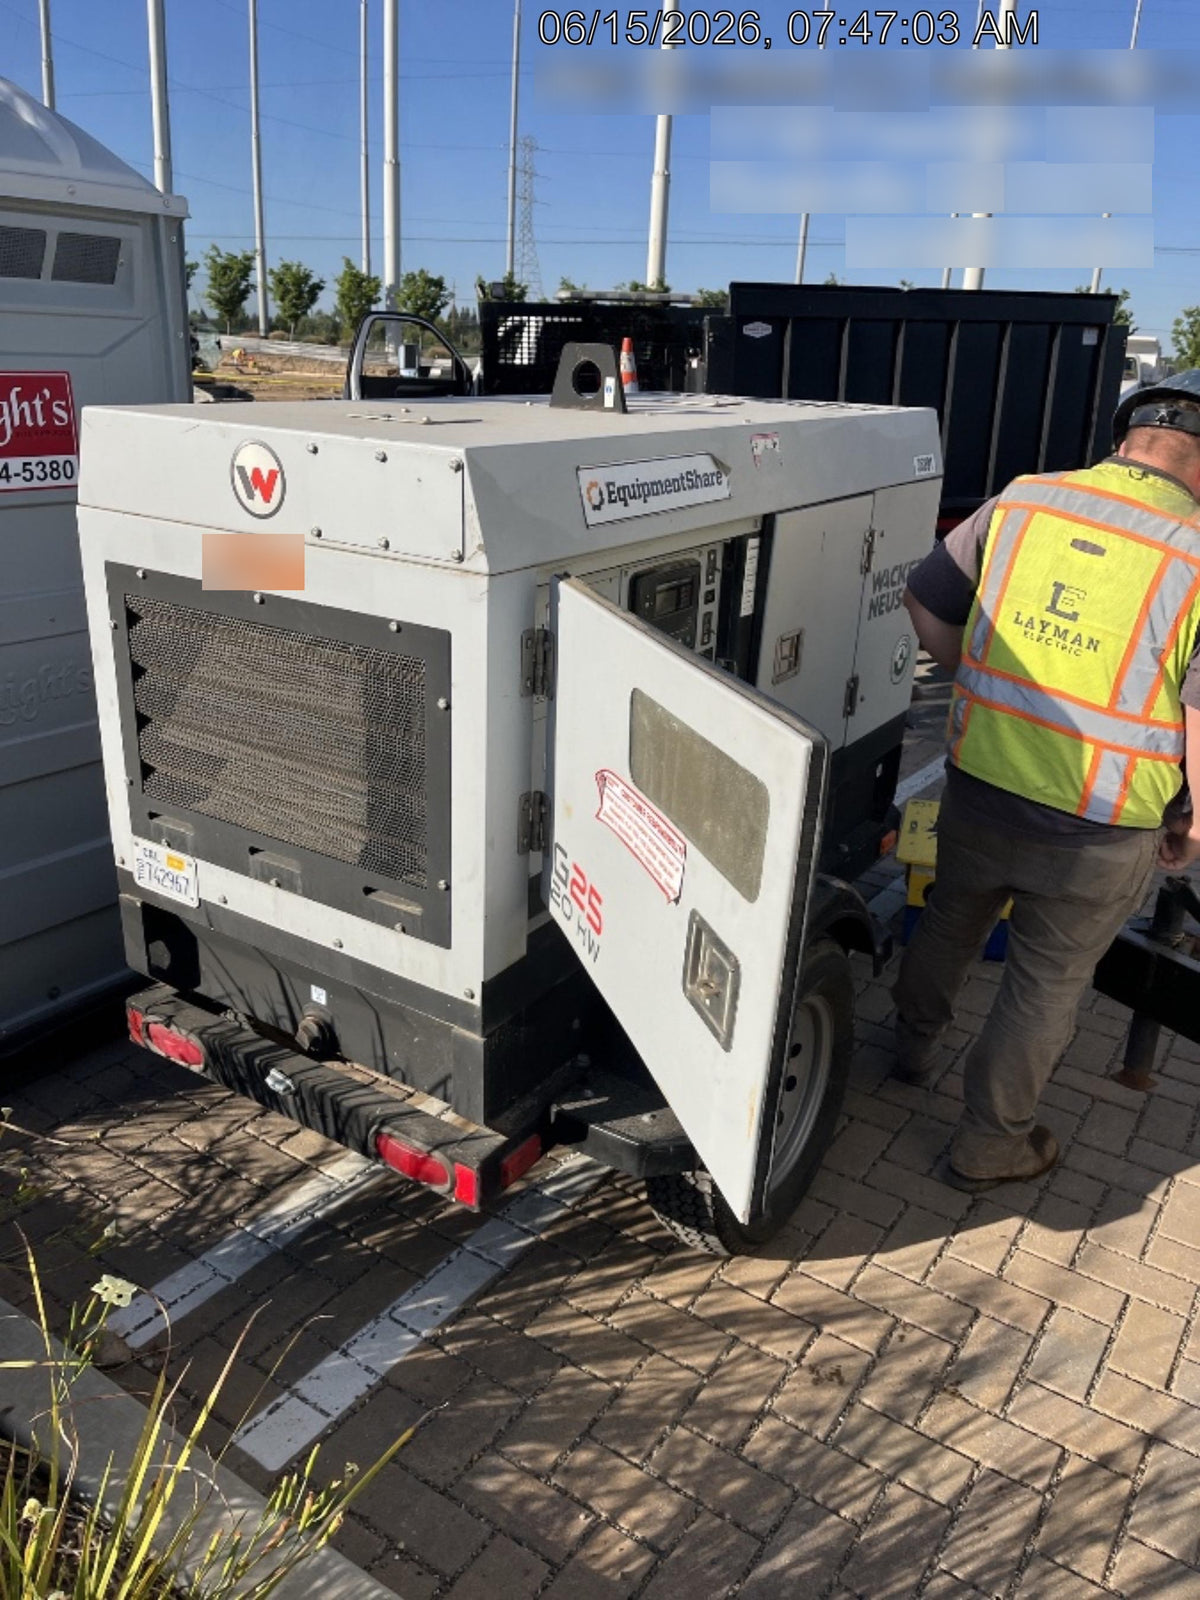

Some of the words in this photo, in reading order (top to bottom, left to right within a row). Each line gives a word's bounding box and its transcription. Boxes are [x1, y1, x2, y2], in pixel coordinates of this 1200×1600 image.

[605, 469, 723, 508] EquipmentShare
[872, 559, 922, 594] WACK
[868, 588, 904, 621] NEUS
[1013, 611, 1101, 653] LAYMAN
[1023, 630, 1083, 657] ELECTRIC
